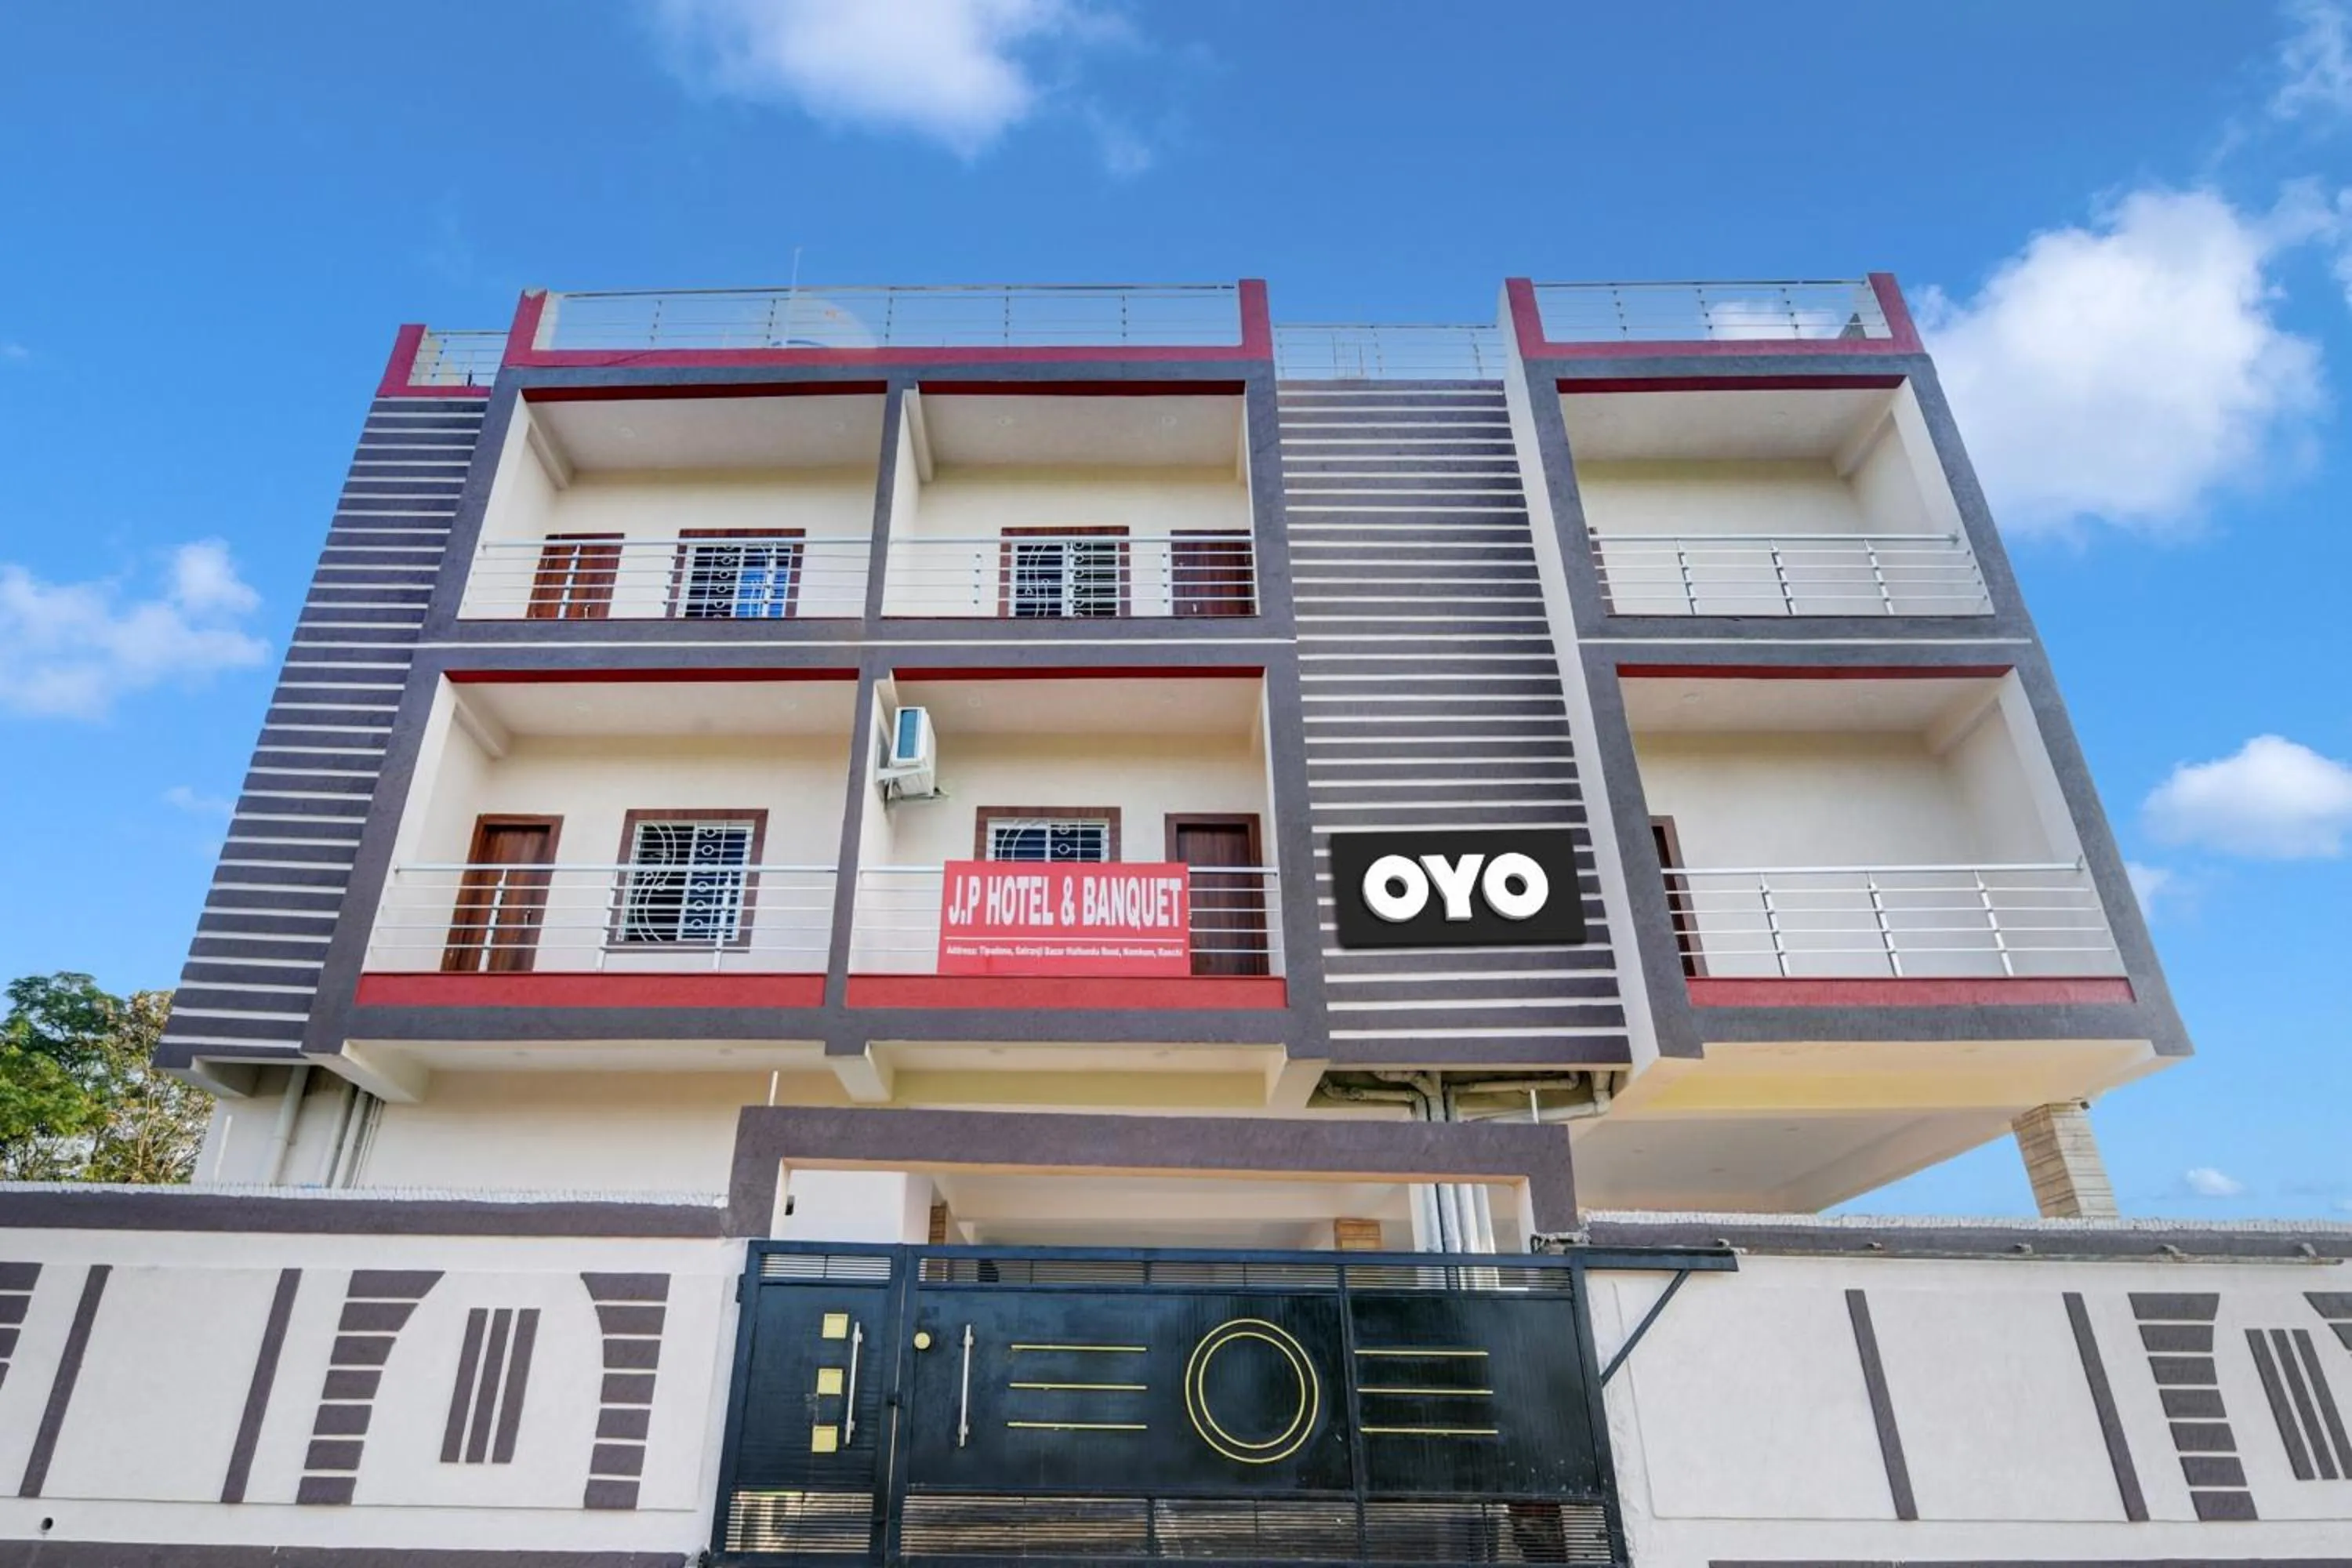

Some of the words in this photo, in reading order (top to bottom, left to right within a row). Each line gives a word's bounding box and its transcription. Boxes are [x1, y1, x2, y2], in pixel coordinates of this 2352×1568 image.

[949, 875, 981, 926] J.P
[985, 875, 1054, 926] HOTEL
[1060, 875, 1076, 927] &
[1083, 876, 1183, 931] BANQUET
[1362, 851, 1549, 923] OYO
